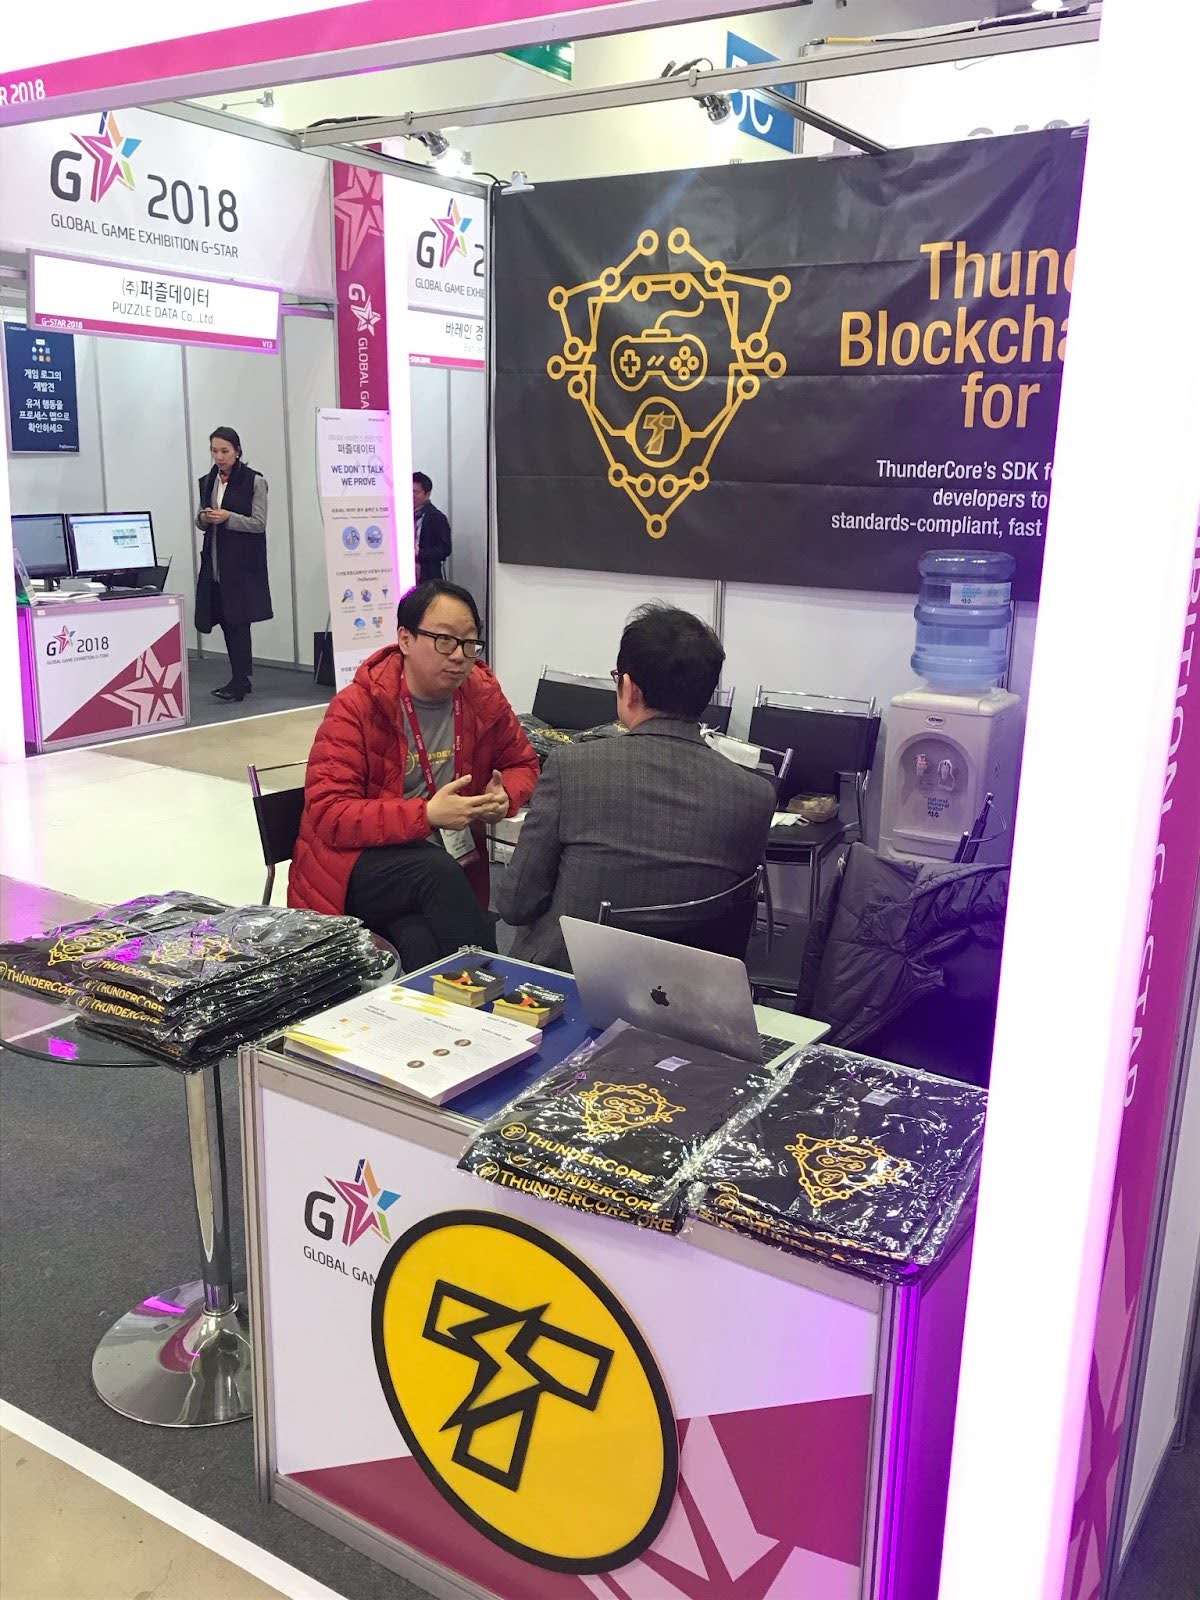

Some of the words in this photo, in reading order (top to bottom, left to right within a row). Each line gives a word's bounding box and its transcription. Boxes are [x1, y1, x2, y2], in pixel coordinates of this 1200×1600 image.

[10, 79, 45, 104] 2018
[147, 174, 239, 232] 2018
[51, 213, 98, 235] GLOBAL
[101, 222, 136, 241] GAME
[139, 229, 199, 252] EXHIBITION
[201, 240, 239, 259] G-STAR
[121, 277, 210, 308] (주)퍼즐데이터
[415, 278, 443, 292] GLOBAL
[445, 283, 465, 296] GAME
[112, 301, 151, 317] PUZZLE
[154, 306, 178, 320] DATA
[41, 318, 66, 327] G-STAR
[67, 320, 83, 329] 2018
[445, 321, 473, 340] 바레인
[357, 337, 369, 387] GLOBAL
[24, 369, 39, 379] 게임
[40, 370, 62, 381] 로그의
[25, 398, 41, 409] 유저
[961, 371, 1041, 429] for
[19, 411, 48, 421] 프로세스
[28, 423, 64, 433] 확인하세요
[337, 444, 376, 454] 퍼즐데이터
[331, 465, 342, 474] WE
[368, 465, 384, 474] TALK
[876, 459, 995, 480] ThunderCore's
[1002, 461, 1039, 480] SDK
[341, 478, 352, 486] WE
[353, 478, 376, 486] PROVE
[932, 488, 1025, 510] developers
[1030, 490, 1048, 509] to
[831, 512, 1003, 538] standards-compliant,
[1008, 515, 1042, 537] fast
[77, 636, 109, 653] 2018
[303, 1245, 349, 1276] GLOBAL
